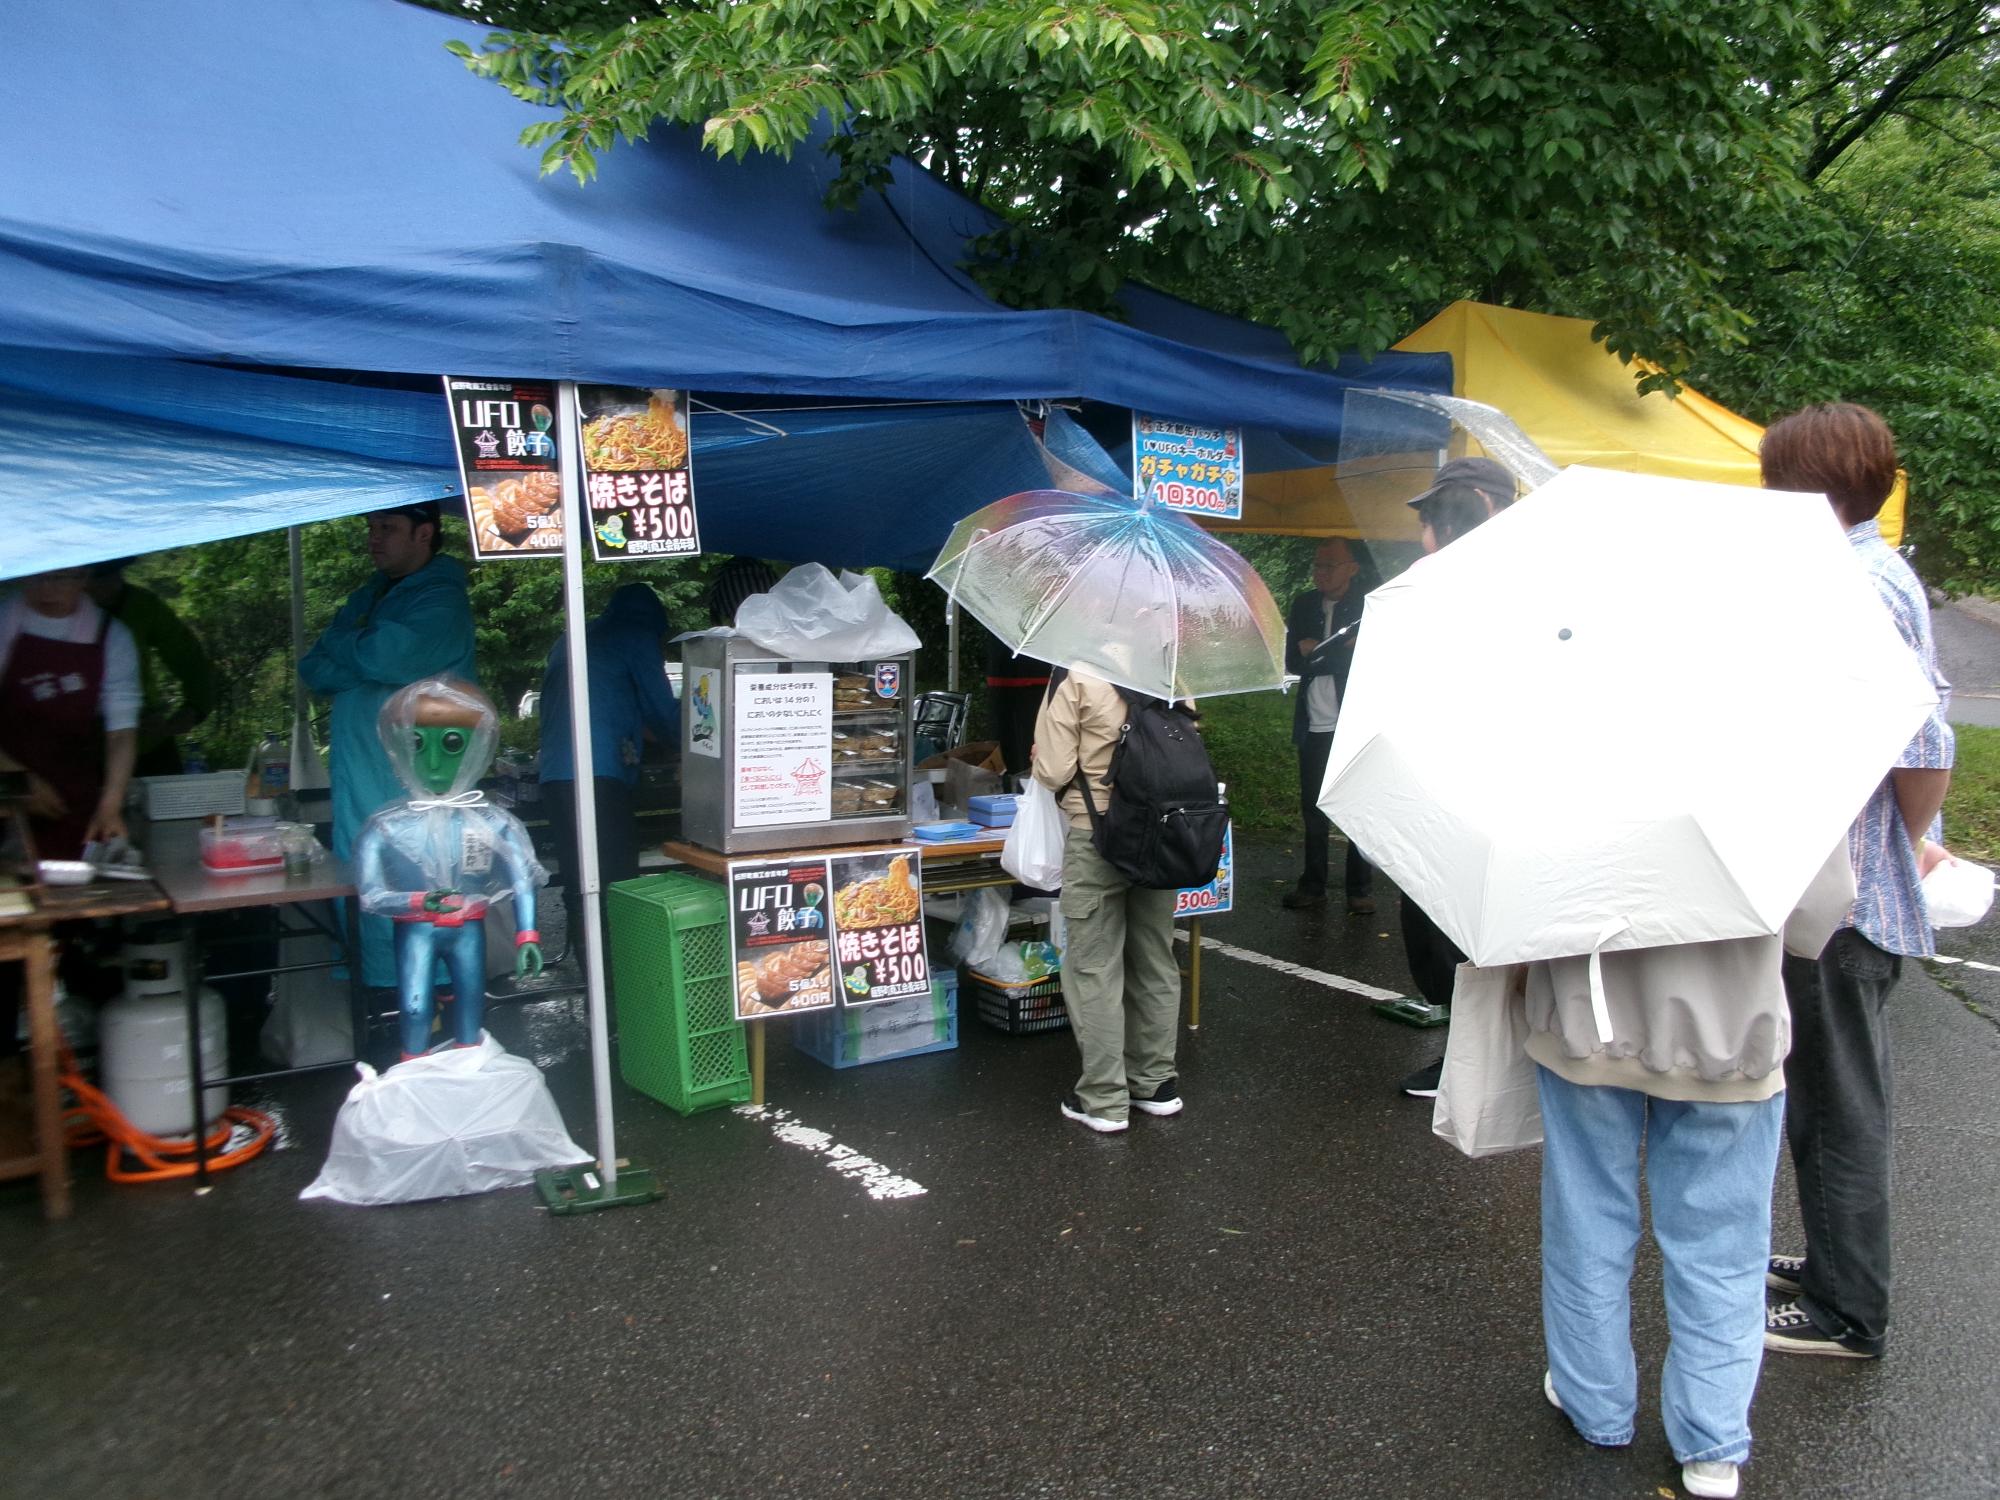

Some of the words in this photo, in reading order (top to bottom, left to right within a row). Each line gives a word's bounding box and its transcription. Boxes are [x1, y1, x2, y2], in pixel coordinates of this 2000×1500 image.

[462, 400, 521, 428] UFO
[506, 429, 548, 456] 餃子
[1140, 456, 1237, 486] ガチャガチャ
[589, 472, 687, 509] 焼きそば
[1156, 483, 1226, 512] 1回300円
[632, 506, 693, 539] ¥500
[747, 709, 822, 719] においの少ないにんにく
[741, 884, 793, 912] UFO
[777, 907, 817, 932] 餃子
[839, 924, 920, 963] 焼きそば
[874, 953, 925, 984] ¥500
[790, 991, 831, 1008] 400円
